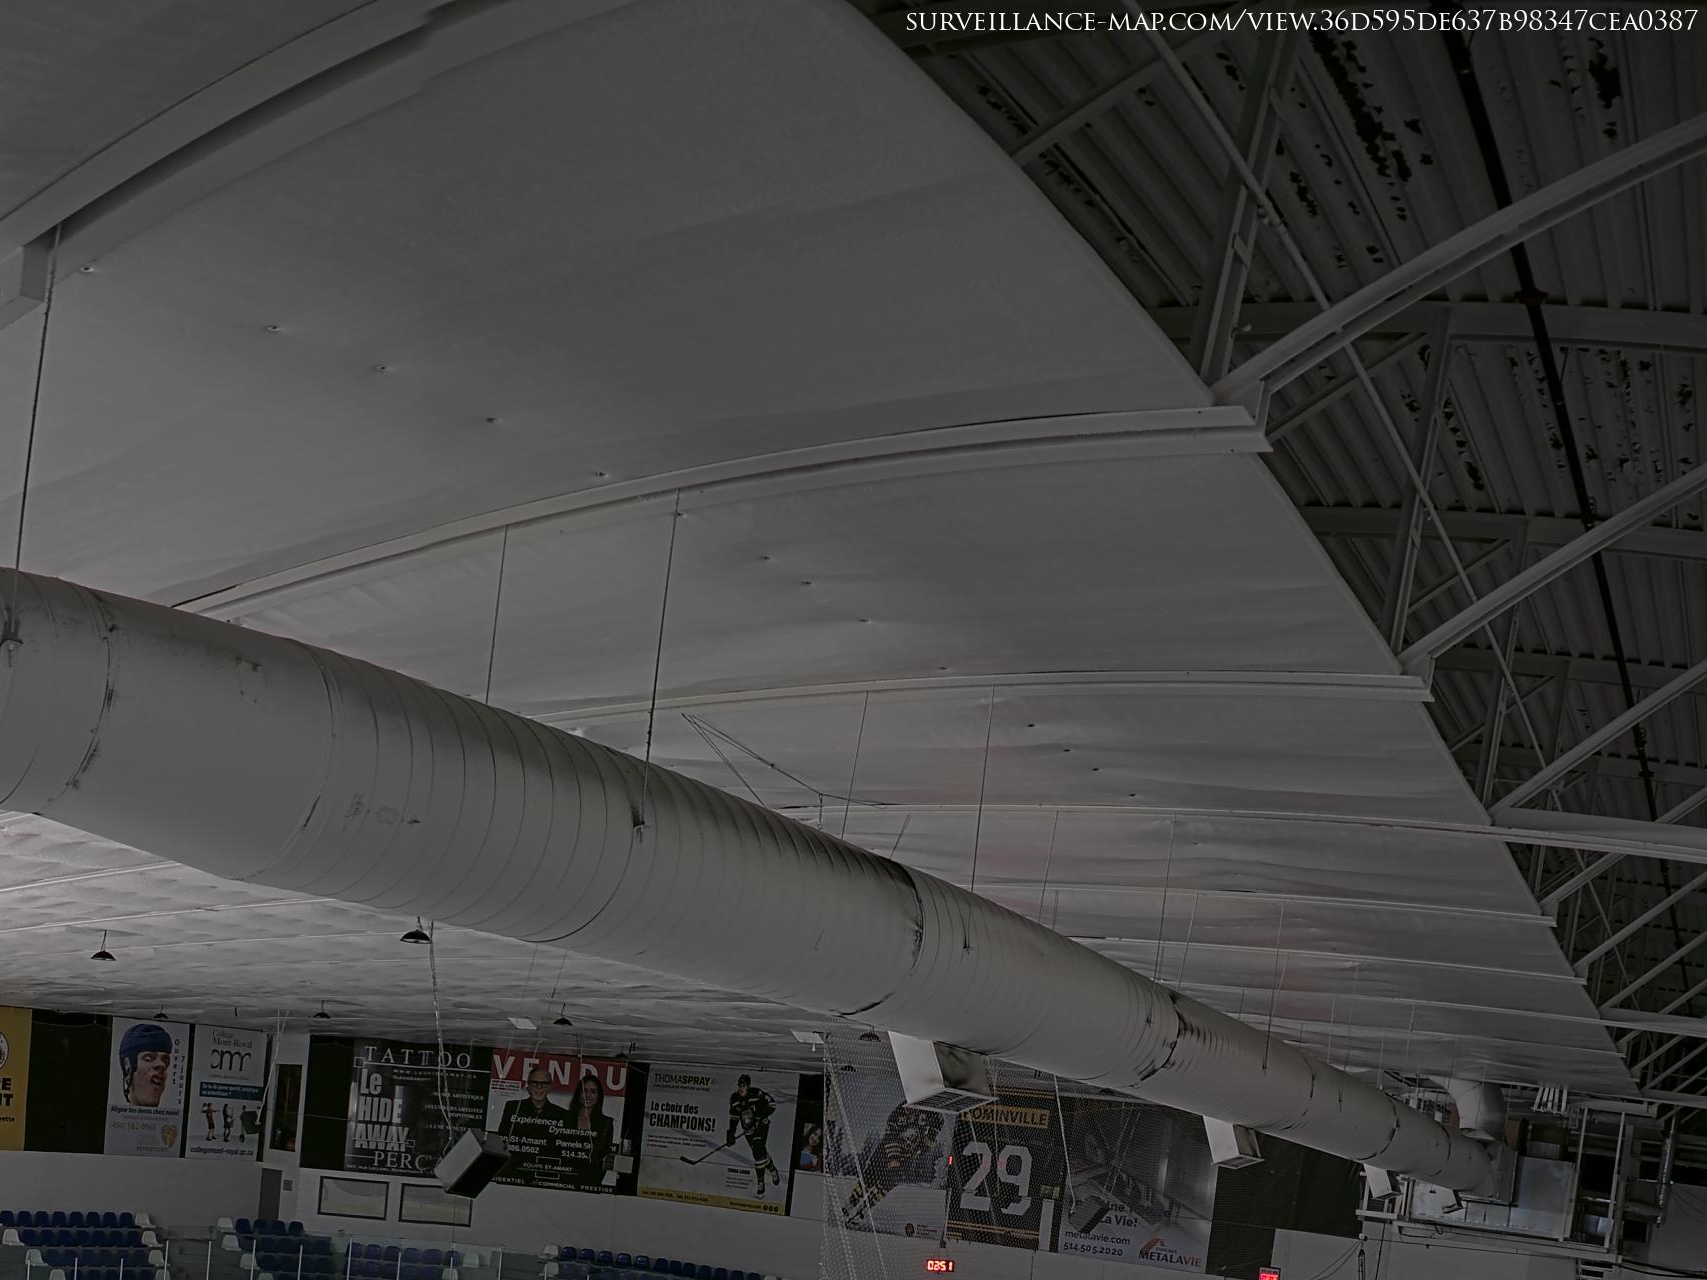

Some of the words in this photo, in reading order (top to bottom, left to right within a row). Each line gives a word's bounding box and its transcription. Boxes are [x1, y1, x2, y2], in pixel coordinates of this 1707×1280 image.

[364, 1045, 471, 1068] TATTOO
[492, 1054, 627, 1091] VENDU
[654, 1073, 711, 1086] THOMASPRAY
[360, 1068, 383, 1095] Le
[111, 1104, 128, 1113] Aligne
[138, 1107, 152, 1115] dents
[357, 1096, 404, 1124] HIDE
[651, 1100, 660, 1111] Le
[660, 1101, 683, 1113] choix
[683, 1103, 699, 1115] des
[510, 1115, 557, 1127] Expérience
[649, 1112, 716, 1132] CHAMPIONS!
[354, 1122, 409, 1152] AWAY
[549, 1125, 598, 1138] Dynamisme
[509, 1134, 547, 1146] St-Amant
[556, 1139, 581, 1149] Pamela
[960, 1141, 1032, 1215] 29
[1114, 1215, 1137, 1228] Vie!
[1139, 1252, 1202, 1267] METALAVIE
